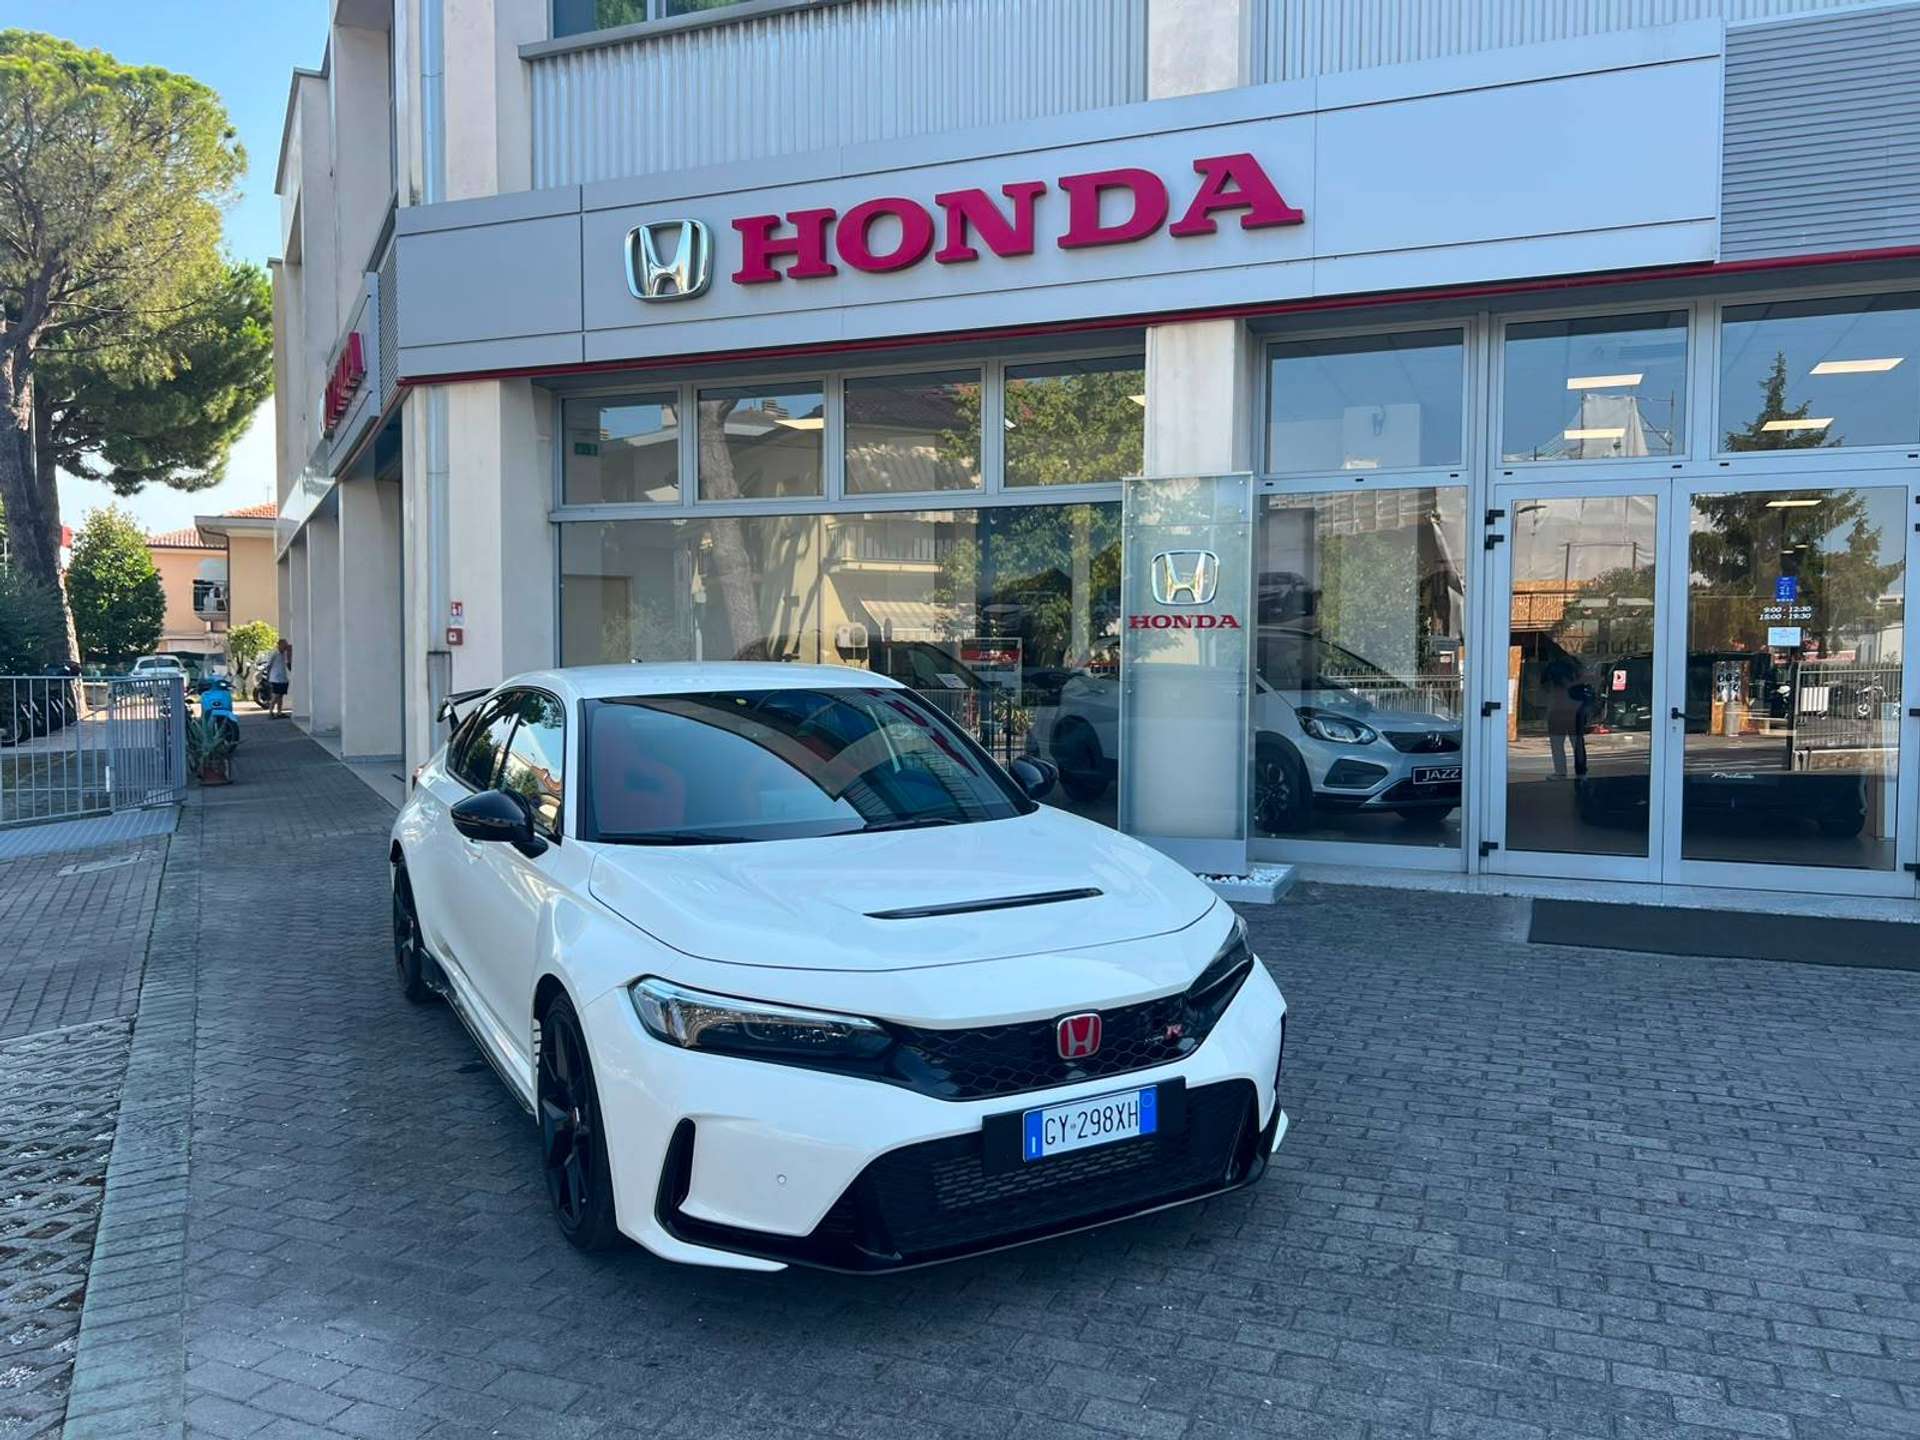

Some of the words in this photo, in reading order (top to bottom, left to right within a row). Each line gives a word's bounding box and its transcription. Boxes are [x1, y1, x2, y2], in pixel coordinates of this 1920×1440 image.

[732, 153, 1304, 285] HONDA
[1128, 614, 1241, 629] HONDA
[1422, 768, 1460, 782] JAZZ
[1045, 1114, 1070, 1145] GY
[1077, 1100, 1139, 1140] 298XH
